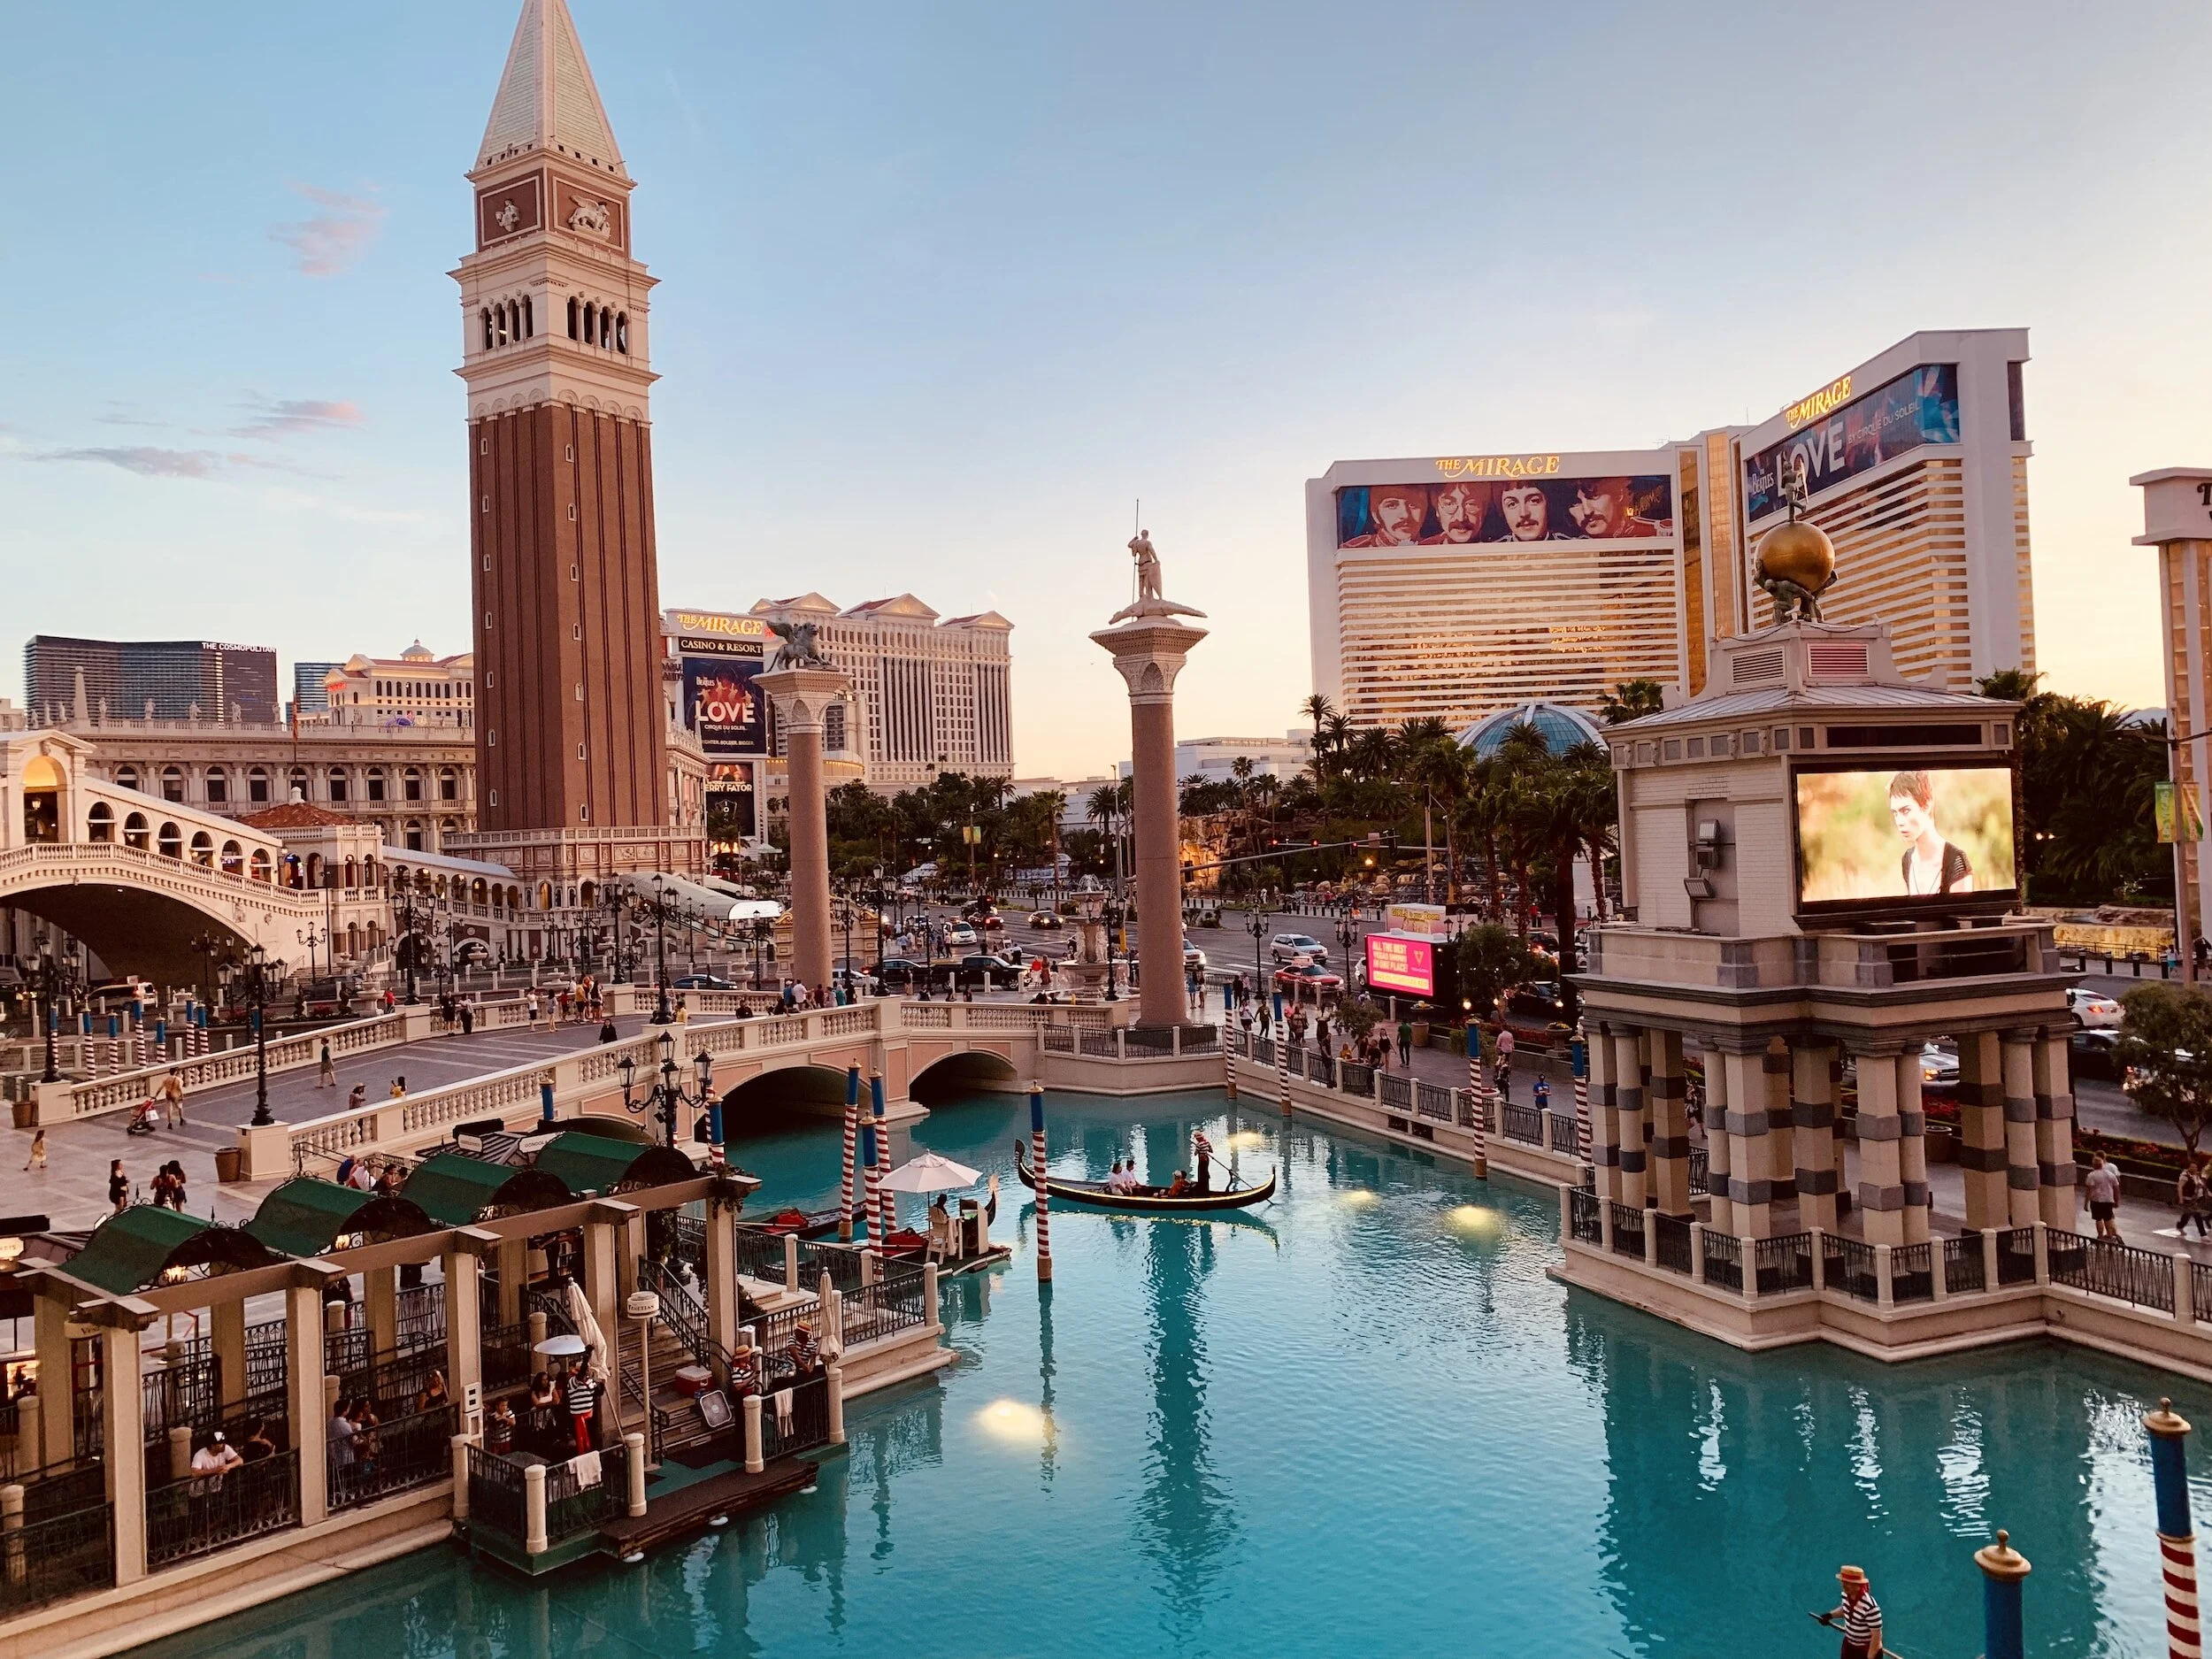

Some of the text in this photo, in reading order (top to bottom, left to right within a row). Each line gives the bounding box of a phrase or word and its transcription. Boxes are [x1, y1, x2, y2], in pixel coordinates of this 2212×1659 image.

[1786, 375, 1852, 429] THE MIRAGE
[1858, 419, 1882, 439] CIRQUE
[1883, 414, 1893, 426] DU
[1895, 401, 1919, 420] SOLEIL
[1435, 456, 1560, 478] THE MIRAGE
[1776, 420, 1846, 497] LOVE
[1752, 472, 1775, 495] BEATLES
[677, 614, 696, 624] THE
[683, 616, 763, 635] MIRAGE
[219, 643, 276, 653] COSMOPOLITAN
[680, 639, 717, 650] CASINO
[726, 643, 762, 654] RESORT
[695, 676, 715, 687] BEATLES
[695, 700, 756, 723] LOVE
[1372, 941, 1382, 951] ALL
[1382, 941, 1394, 953] THE
